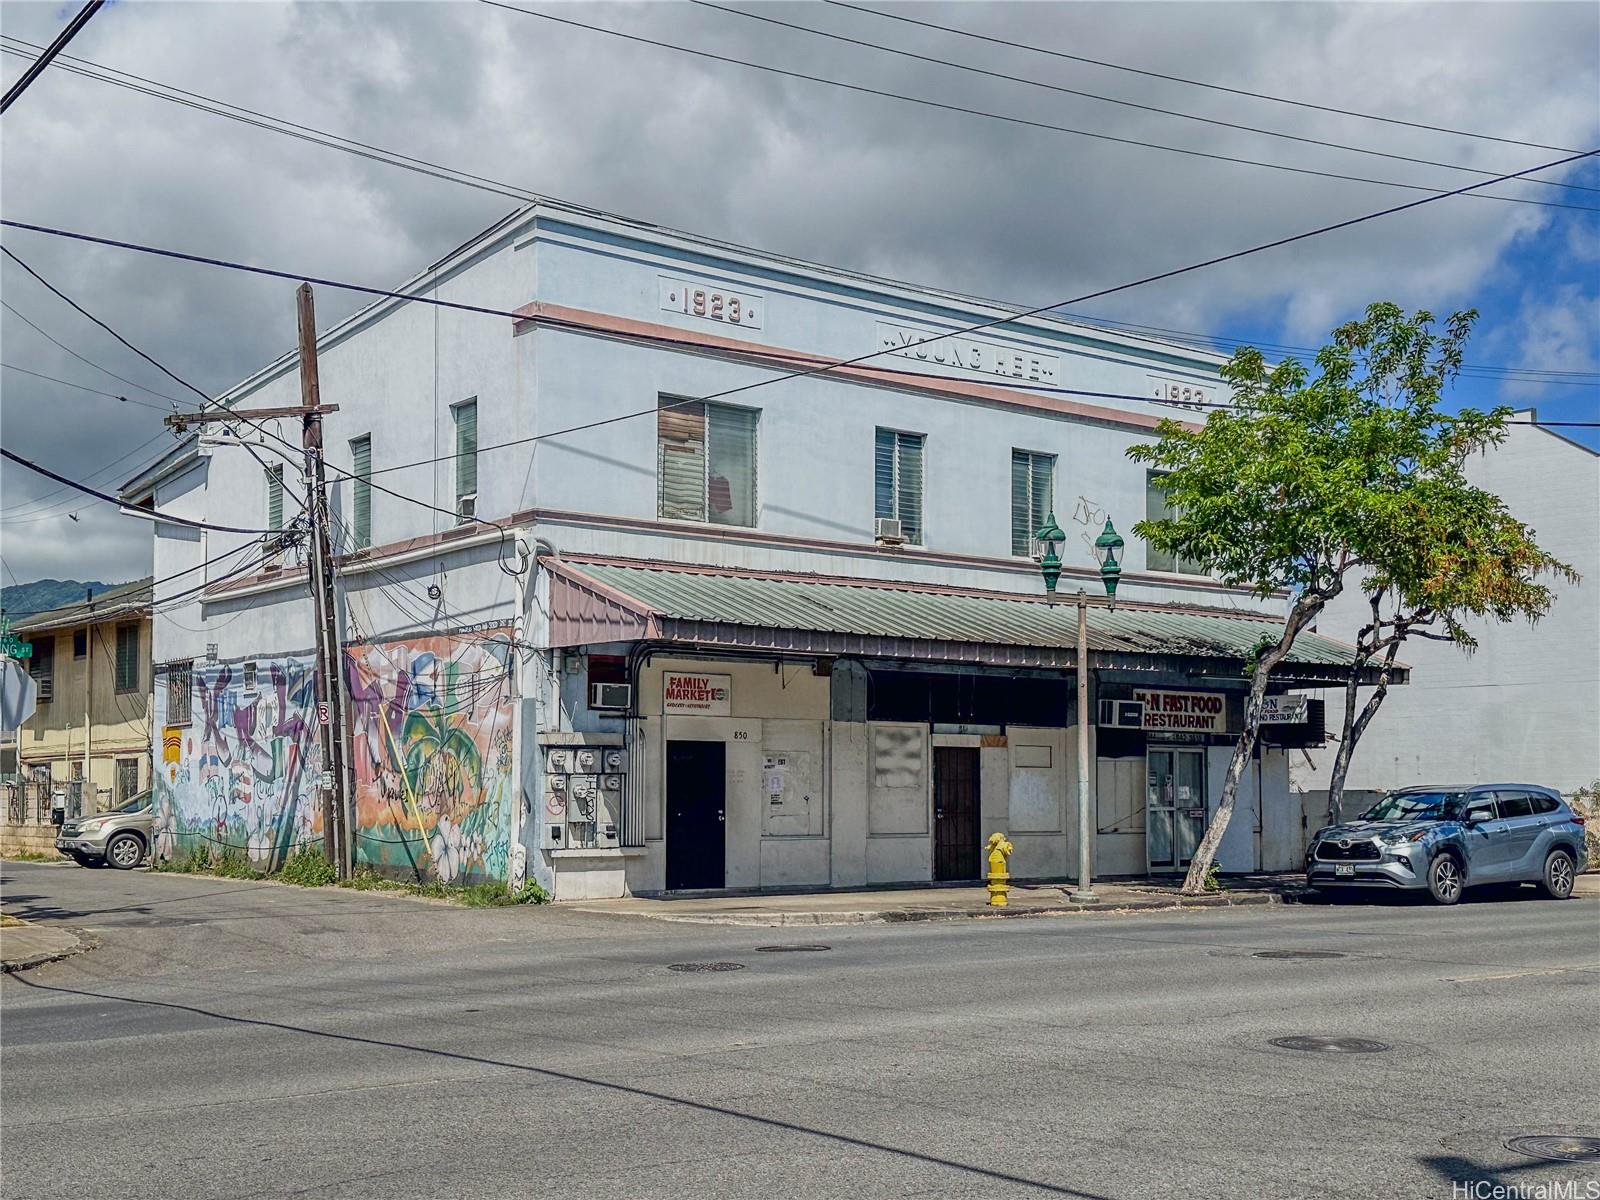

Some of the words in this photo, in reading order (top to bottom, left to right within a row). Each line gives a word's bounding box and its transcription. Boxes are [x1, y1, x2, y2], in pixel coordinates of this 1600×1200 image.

[683, 287, 741, 323] 1923
[899, 331, 981, 369] YOUNG
[1164, 383, 1204, 411] 1923
[1, 643, 17, 656] NG
[669, 676, 709, 690] FAMILY
[666, 687, 711, 701] MARKET
[1163, 694, 1190, 712] FAST
[1190, 696, 1222, 714] FOOD
[1144, 713, 1216, 729] RESTAURANT
[734, 731, 748, 740] 850
